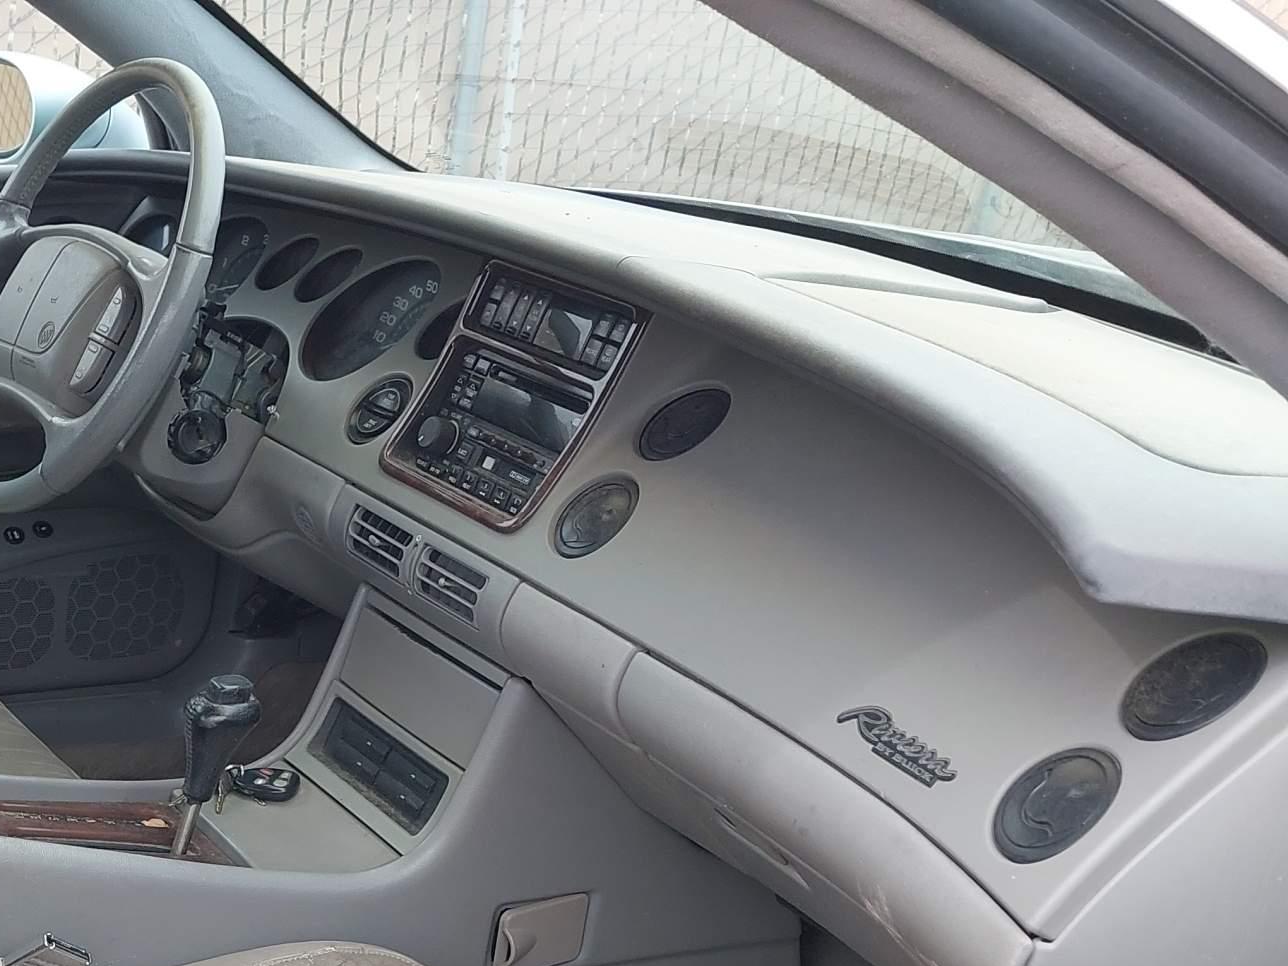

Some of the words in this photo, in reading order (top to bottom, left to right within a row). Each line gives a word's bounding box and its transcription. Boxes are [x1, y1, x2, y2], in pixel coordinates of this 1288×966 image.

[409, 285, 423, 298] 40
[425, 279, 439, 294] 50
[392, 296, 409, 311] 30
[379, 311, 397, 326] 20
[372, 329, 386, 343] 10
[875, 742, 894, 757] BY
[893, 753, 934, 782] BUICK
